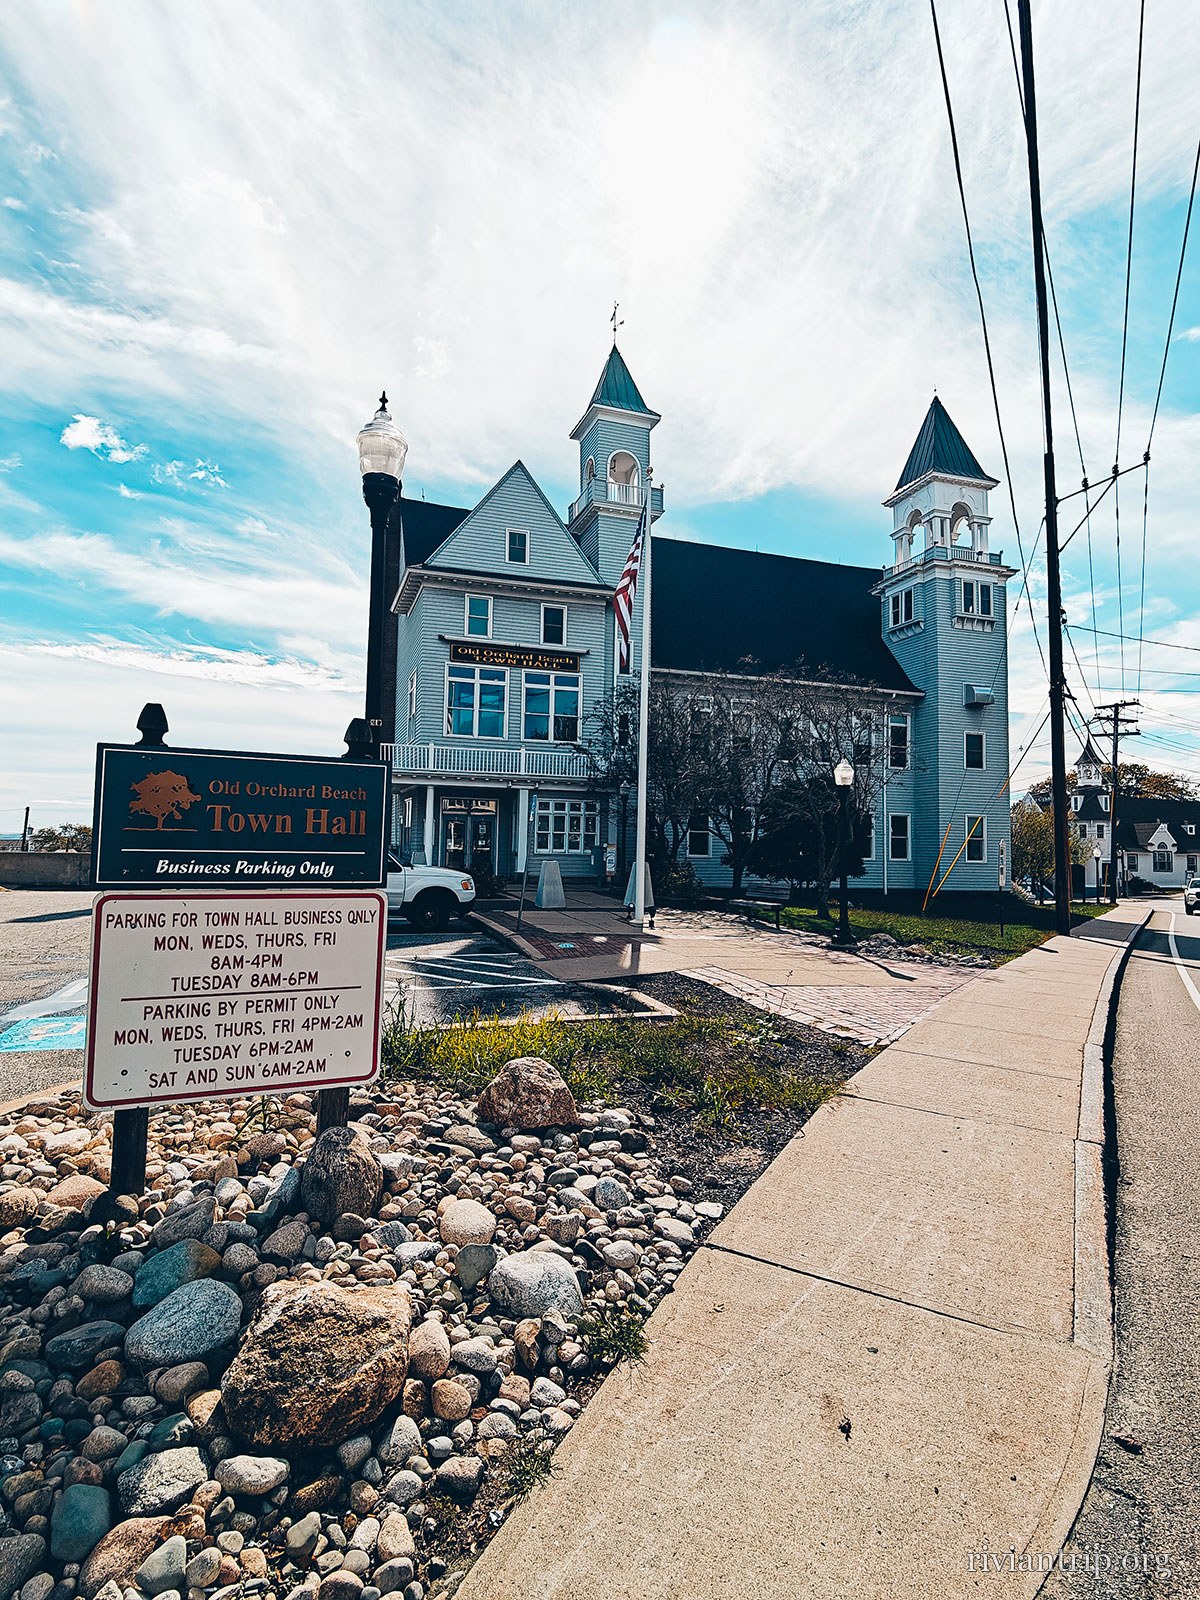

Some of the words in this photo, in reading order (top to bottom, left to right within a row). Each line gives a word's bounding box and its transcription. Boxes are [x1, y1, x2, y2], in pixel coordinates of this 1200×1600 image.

[458, 647, 479, 655] Old
[483, 649, 533, 660] Orchard
[473, 655, 517, 665] TOWN
[523, 660, 561, 669] HALL
[208, 780, 240, 795] Old
[246, 782, 315, 798] Orchard
[321, 786, 366, 800] Beach
[206, 804, 292, 834] Town
[304, 808, 366, 835] Hall
[156, 860, 230, 874] Business
[235, 861, 296, 878] Parking
[300, 862, 334, 877] Only
[106, 913, 166, 929] PARKING
[172, 912, 198, 927] FOR
[204, 912, 240, 927] TOWN
[245, 912, 278, 926] HALL
[284, 910, 342, 925] BUSINESS
[348, 910, 377, 924] ONLY
[154, 935, 193, 951] MON,
[202, 934, 248, 949] WEDS,
[256, 932, 307, 948] THURS,
[314, 932, 337, 946] FRI
[211, 954, 282, 970] 8AM-4PM
[171, 974, 243, 992] TUESDAY
[250, 972, 318, 988] 8AM-6PM
[143, 1002, 211, 1020] PARKING
[218, 1001, 238, 1016] BY
[245, 998, 297, 1014] PERMIT
[304, 995, 340, 1010] ONLY
[114, 1029, 153, 1046] MON,
[161, 1025, 207, 1042] WEDS,
[215, 1020, 266, 1038] THURS,
[272, 1019, 295, 1034] FRI
[302, 1014, 363, 1031] 4PM-2AM
[174, 1044, 242, 1064] TUESDAY
[250, 1039, 314, 1057] 6PM-2AM
[148, 1072, 178, 1088] SAT
[186, 1068, 218, 1086] AND
[225, 1064, 255, 1082] SUN
[262, 1059, 326, 1078] 6AM-2AM
